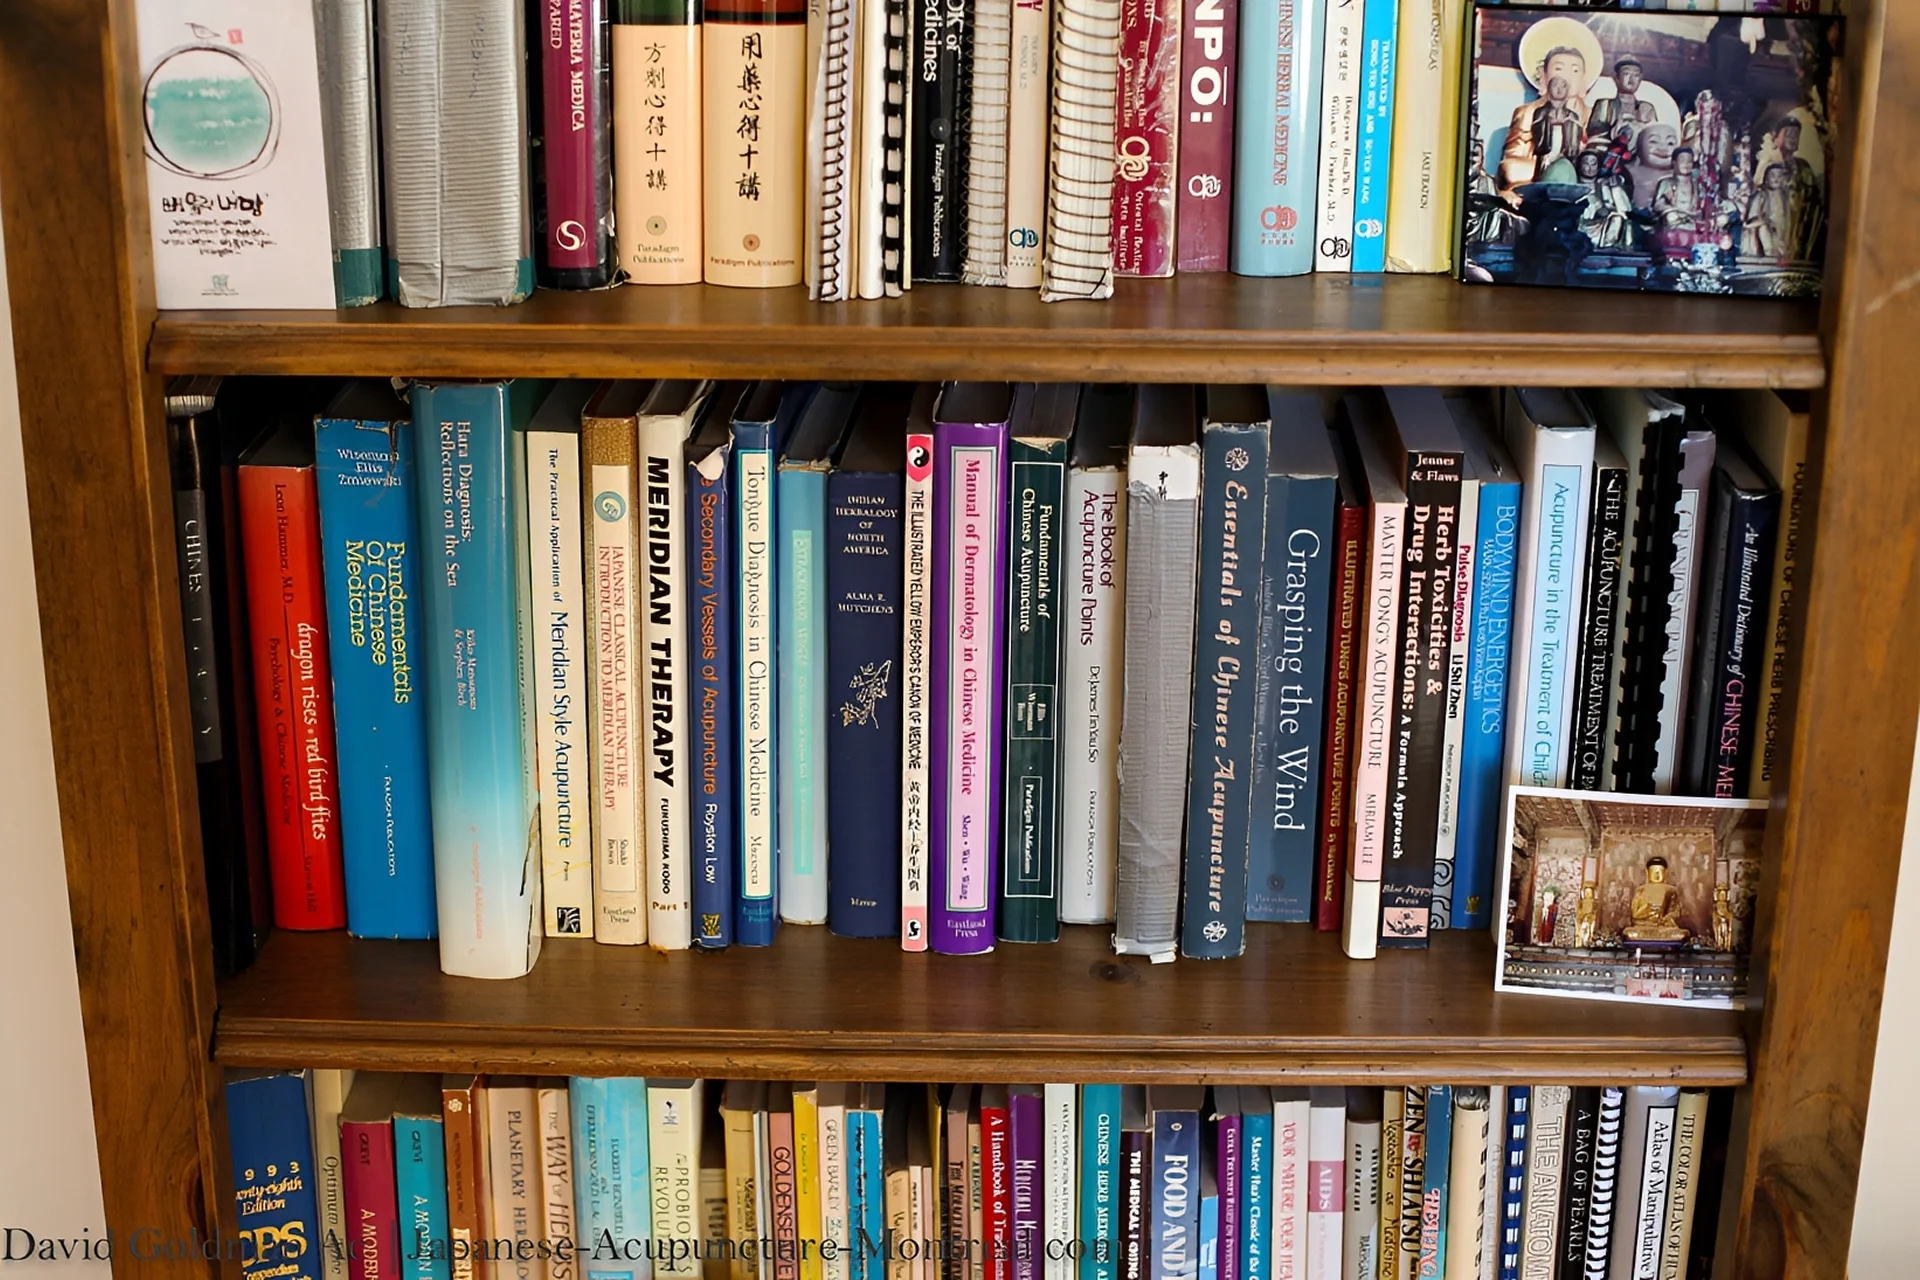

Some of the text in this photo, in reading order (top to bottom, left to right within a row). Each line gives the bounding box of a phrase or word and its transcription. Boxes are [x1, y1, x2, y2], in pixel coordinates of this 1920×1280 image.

[570, 71, 585, 131] MEDICA
[1275, 53, 1292, 110] HERBAL
[931, 144, 945, 257] Paradigm Publications
[275, 484, 287, 512] Leon
[440, 421, 460, 588] Reflections on the Sea
[456, 421, 475, 543] Hara Diagnosis:
[548, 449, 559, 468] The
[549, 472, 561, 521] Practical
[847, 496, 886, 504] INDIAN
[1427, 470, 1460, 482] Flaws
[549, 525, 562, 587] Application
[698, 493, 718, 588] Secondary
[843, 546, 889, 555] AMERICA
[847, 533, 885, 542] NORTH
[909, 490, 924, 616] THE ILLUSTRATED YELLOW
[1017, 488, 1035, 632] Chinese Acupuncture
[1037, 505, 1053, 619] Fundamentals of
[1079, 490, 1098, 646] Acupuncture Points
[1099, 490, 1117, 589] The Book of
[345, 540, 366, 647] Medicine
[366, 540, 388, 666] Of Chinese
[386, 541, 414, 704] Fundamentals
[552, 592, 563, 603] of
[647, 456, 674, 788] MERIDIAN THERAPY
[701, 593, 719, 660] Vessels
[845, 592, 873, 601] ALMA
[960, 459, 980, 795] Manual of Dermatology in Chinese Medicine
[1426, 505, 1455, 695] Herb Toxicities &
[1452, 544, 1471, 643] Pulse Diagnosis
[1536, 482, 1570, 737] Acupuncture in the Treatment of
[1762, 462, 1806, 782] FOUNDATIONS PRESCRIBING
[549, 611, 570, 692] Meridian
[598, 546, 616, 811] INTRODUCTION THERAPY
[611, 545, 629, 789] JAPANESE CLASSICAL ACUPUNCTURE
[702, 664, 719, 682] of
[743, 466, 767, 817] Tongue Diagnosis in Chinese Medicine
[1273, 529, 1321, 831] Grasping the Wind
[1330, 540, 1358, 827] ILLUSTRATED POINTS
[1368, 516, 1397, 769] MASTER TONG'S ACUPUNCTURE
[1392, 504, 1430, 859] Drug Interactions: Formula Approach
[1481, 618, 1508, 734] ENERGETICS
[1581, 527, 1618, 771] ACUPUNCTURE TREATMENT OF
[290, 622, 331, 841] dragon rises red bird flies
[549, 694, 573, 736] Style
[701, 687, 719, 796] Acupuncture
[1207, 480, 1248, 912] Essentials of Chinese Acupuncture
[1720, 680, 1745, 755] CHINESE
[551, 739, 573, 848] Acupuncture
[660, 798, 671, 860] FUKUSHIMA
[1364, 793, 1377, 841] MIRIAM
[703, 803, 718, 884] Royston Low
[508, 1110, 525, 1199] PLANETARY
[1250, 1136, 1263, 1171] Master
[1282, 1122, 1297, 1157] YOUR
[1405, 1085, 1426, 1134] ZEN
[1534, 1115, 1563, 1169] THE
[323, 1155, 340, 1224] Optimum
[546, 1135, 568, 1184] WAY
[824, 1119, 841, 1210] GREEN BARLEY
[990, 1115, 1006, 1214] A Handbook of
[1015, 1159, 1037, 1213] MEDICINAL
[1097, 1113, 1110, 1203] CHINESE HERB
[1128, 1151, 1141, 1230] THE MEDICAL
[1319, 1163, 1333, 1210] AIDS
[1384, 1118, 1403, 1205] Vegetables as
[1401, 1156, 1424, 1253] SHIATSU
[1567, 1109, 1592, 1262] A BAG OF PEARLS
[1640, 1121, 1669, 1272] Atlas of Manipulative
[1668, 1114, 1696, 1251] THE COLOR ATLAS OF
[238, 1220, 308, 1268] CPS
[242, 1198, 286, 1216] Edition
[360, 1208, 376, 1220] A
[1162, 1154, 1189, 1271] FOOD AND
[1416, 1187, 1440, 1276] HEALING
